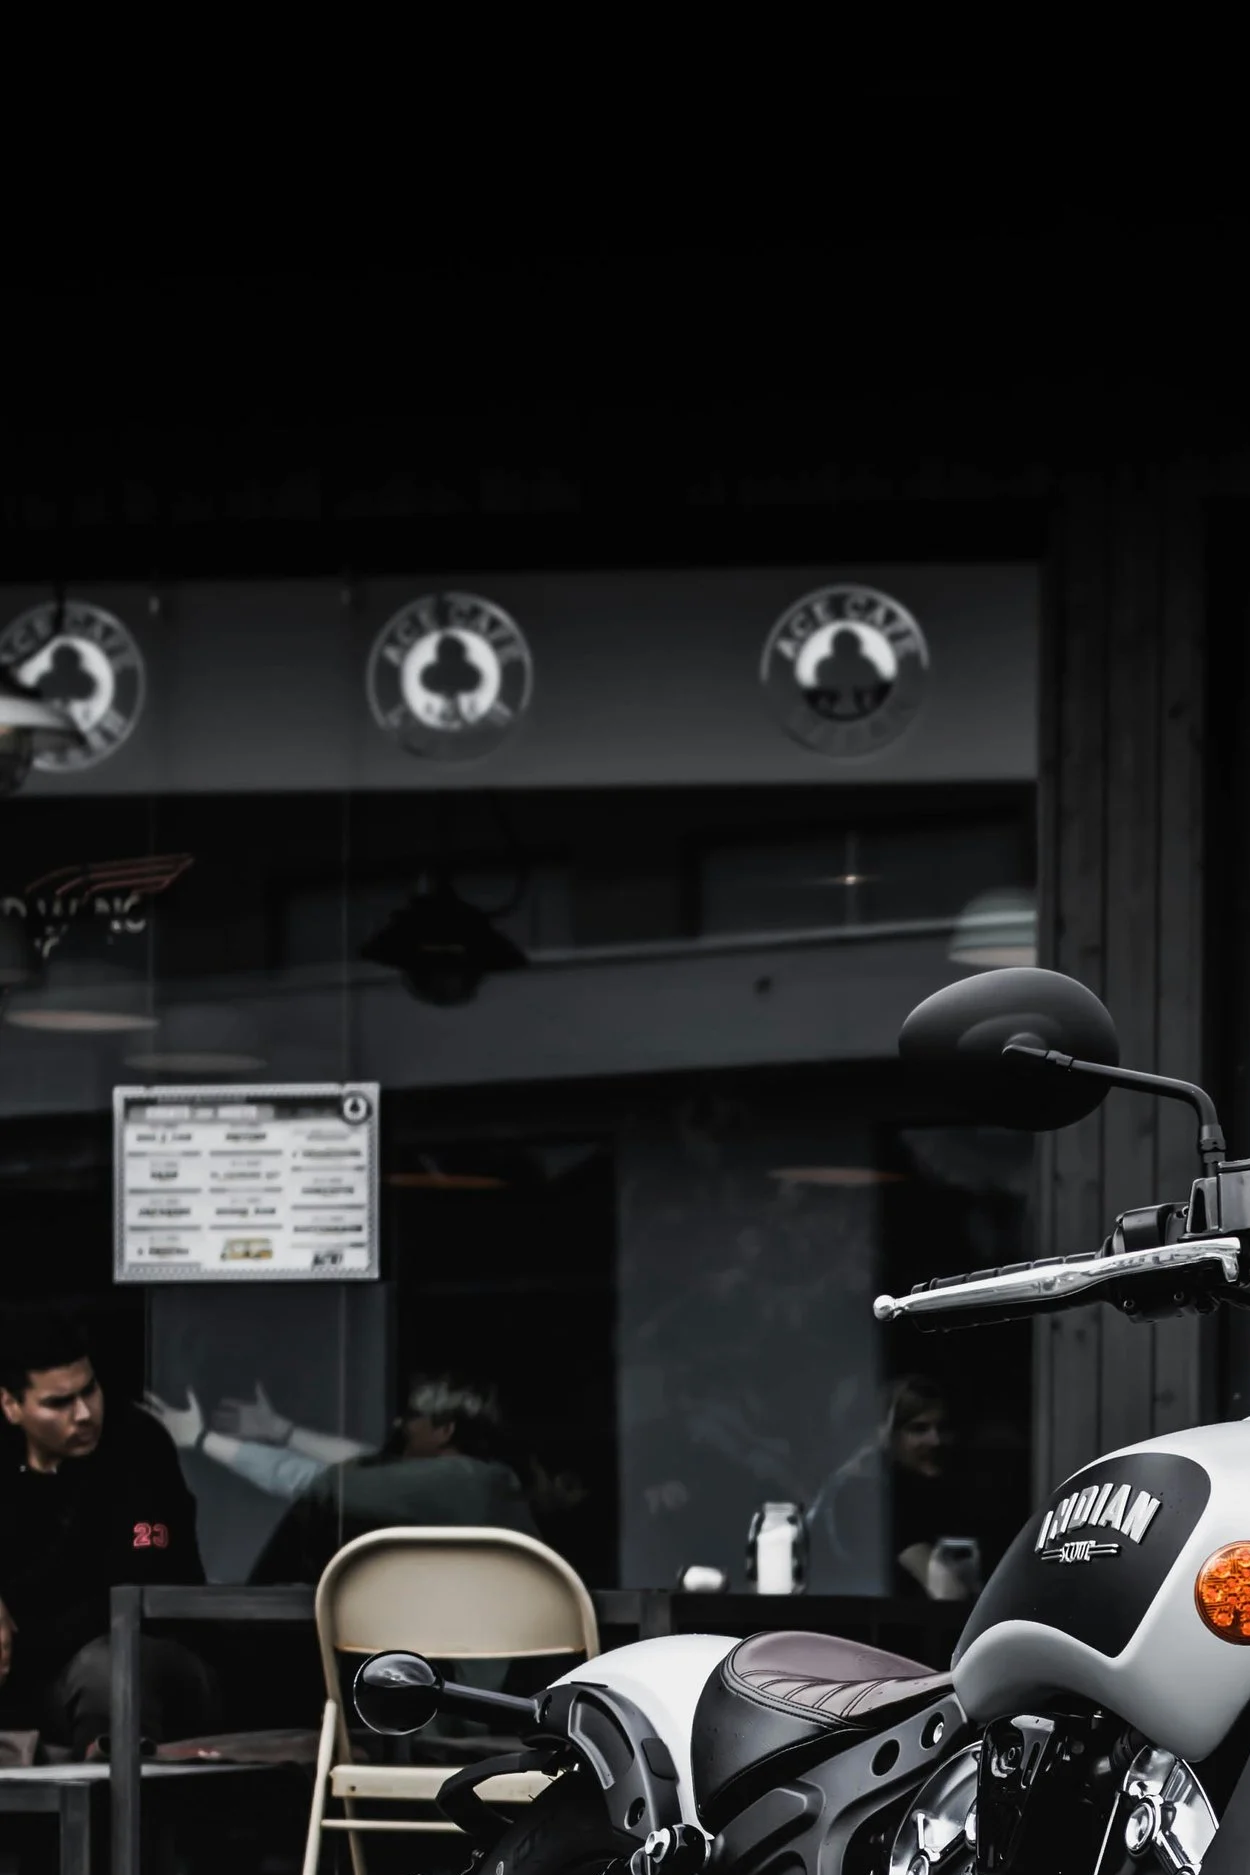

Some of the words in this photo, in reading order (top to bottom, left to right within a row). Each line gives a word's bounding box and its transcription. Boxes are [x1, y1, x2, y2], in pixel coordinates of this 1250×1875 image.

[382, 604, 438, 667] ACE
[448, 600, 525, 664] CAFE
[775, 598, 832, 662] ACE
[843, 594, 921, 657] CAFE
[1035, 1483, 1162, 1553] INDIAN
